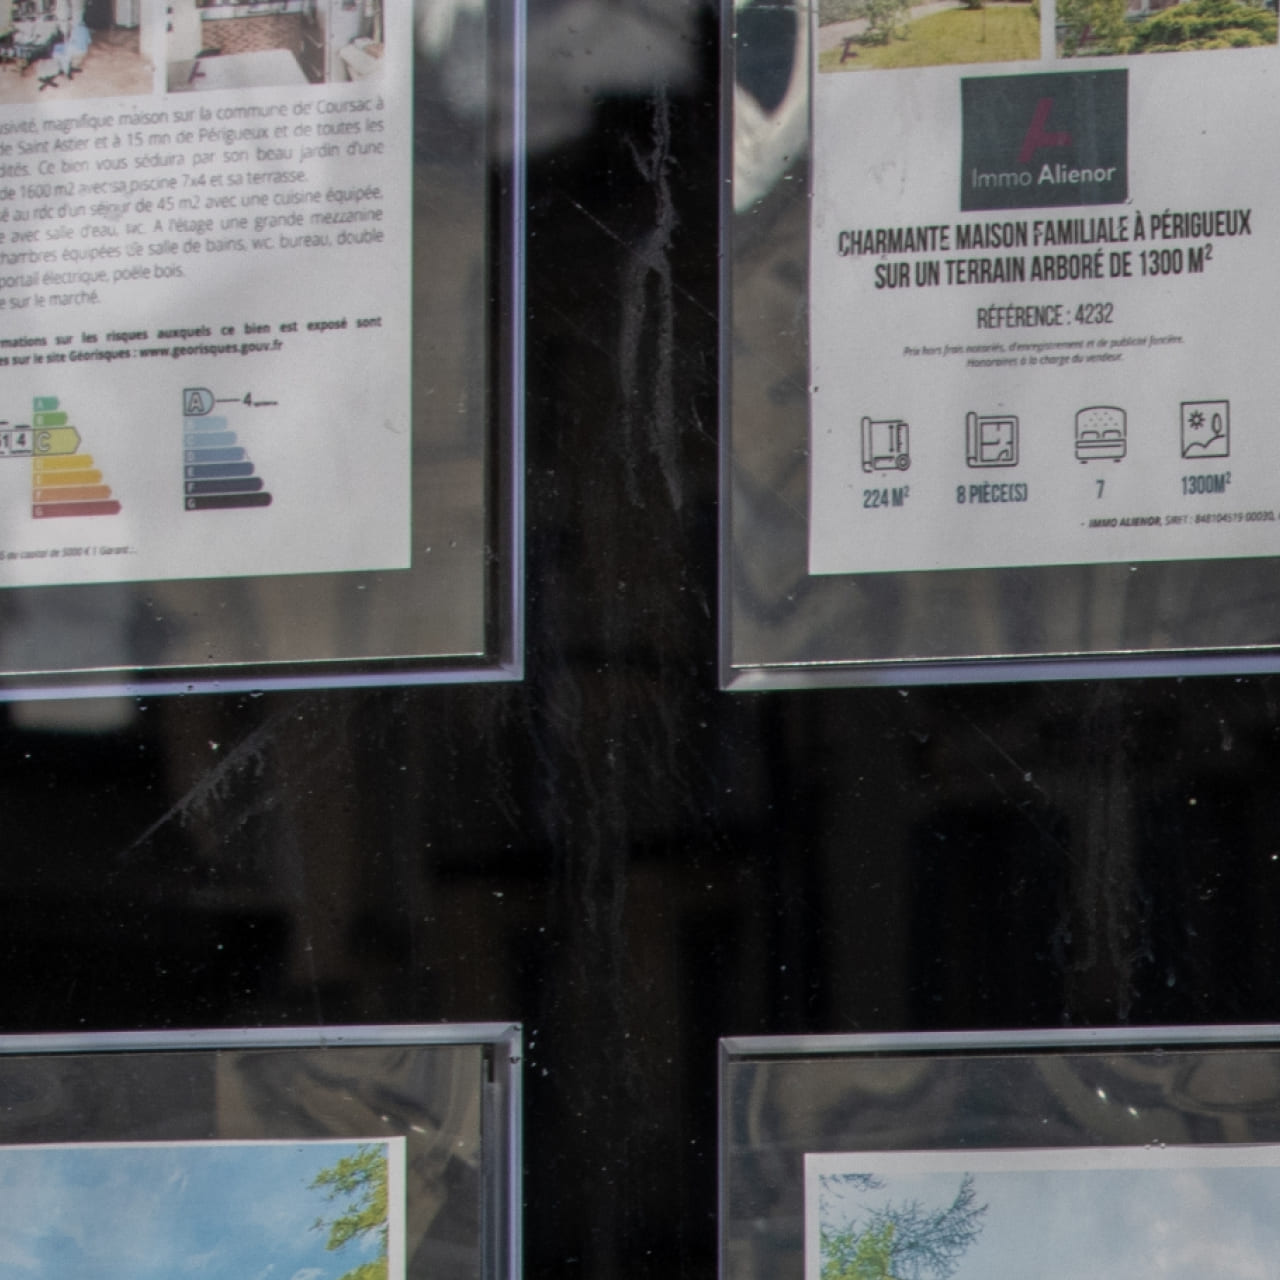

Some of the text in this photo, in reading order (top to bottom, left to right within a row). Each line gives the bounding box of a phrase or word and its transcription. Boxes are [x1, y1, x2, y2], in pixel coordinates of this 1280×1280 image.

[971, 163, 1118, 188] Immo Alienor
[837, 207, 1252, 257] CHARMANTE MAISON FAMILIALE À PÉRIGUEUX
[874, 261, 911, 290] SUR
[914, 260, 941, 288] UN
[943, 255, 1026, 286] TERRAIN
[1029, 247, 1105, 282] ARBORÉ
[1109, 250, 1133, 279] DE
[1138, 247, 1184, 277] 1300
[976, 302, 1065, 330] RÉFÉRENCE
[1073, 301, 1115, 326] 4232
